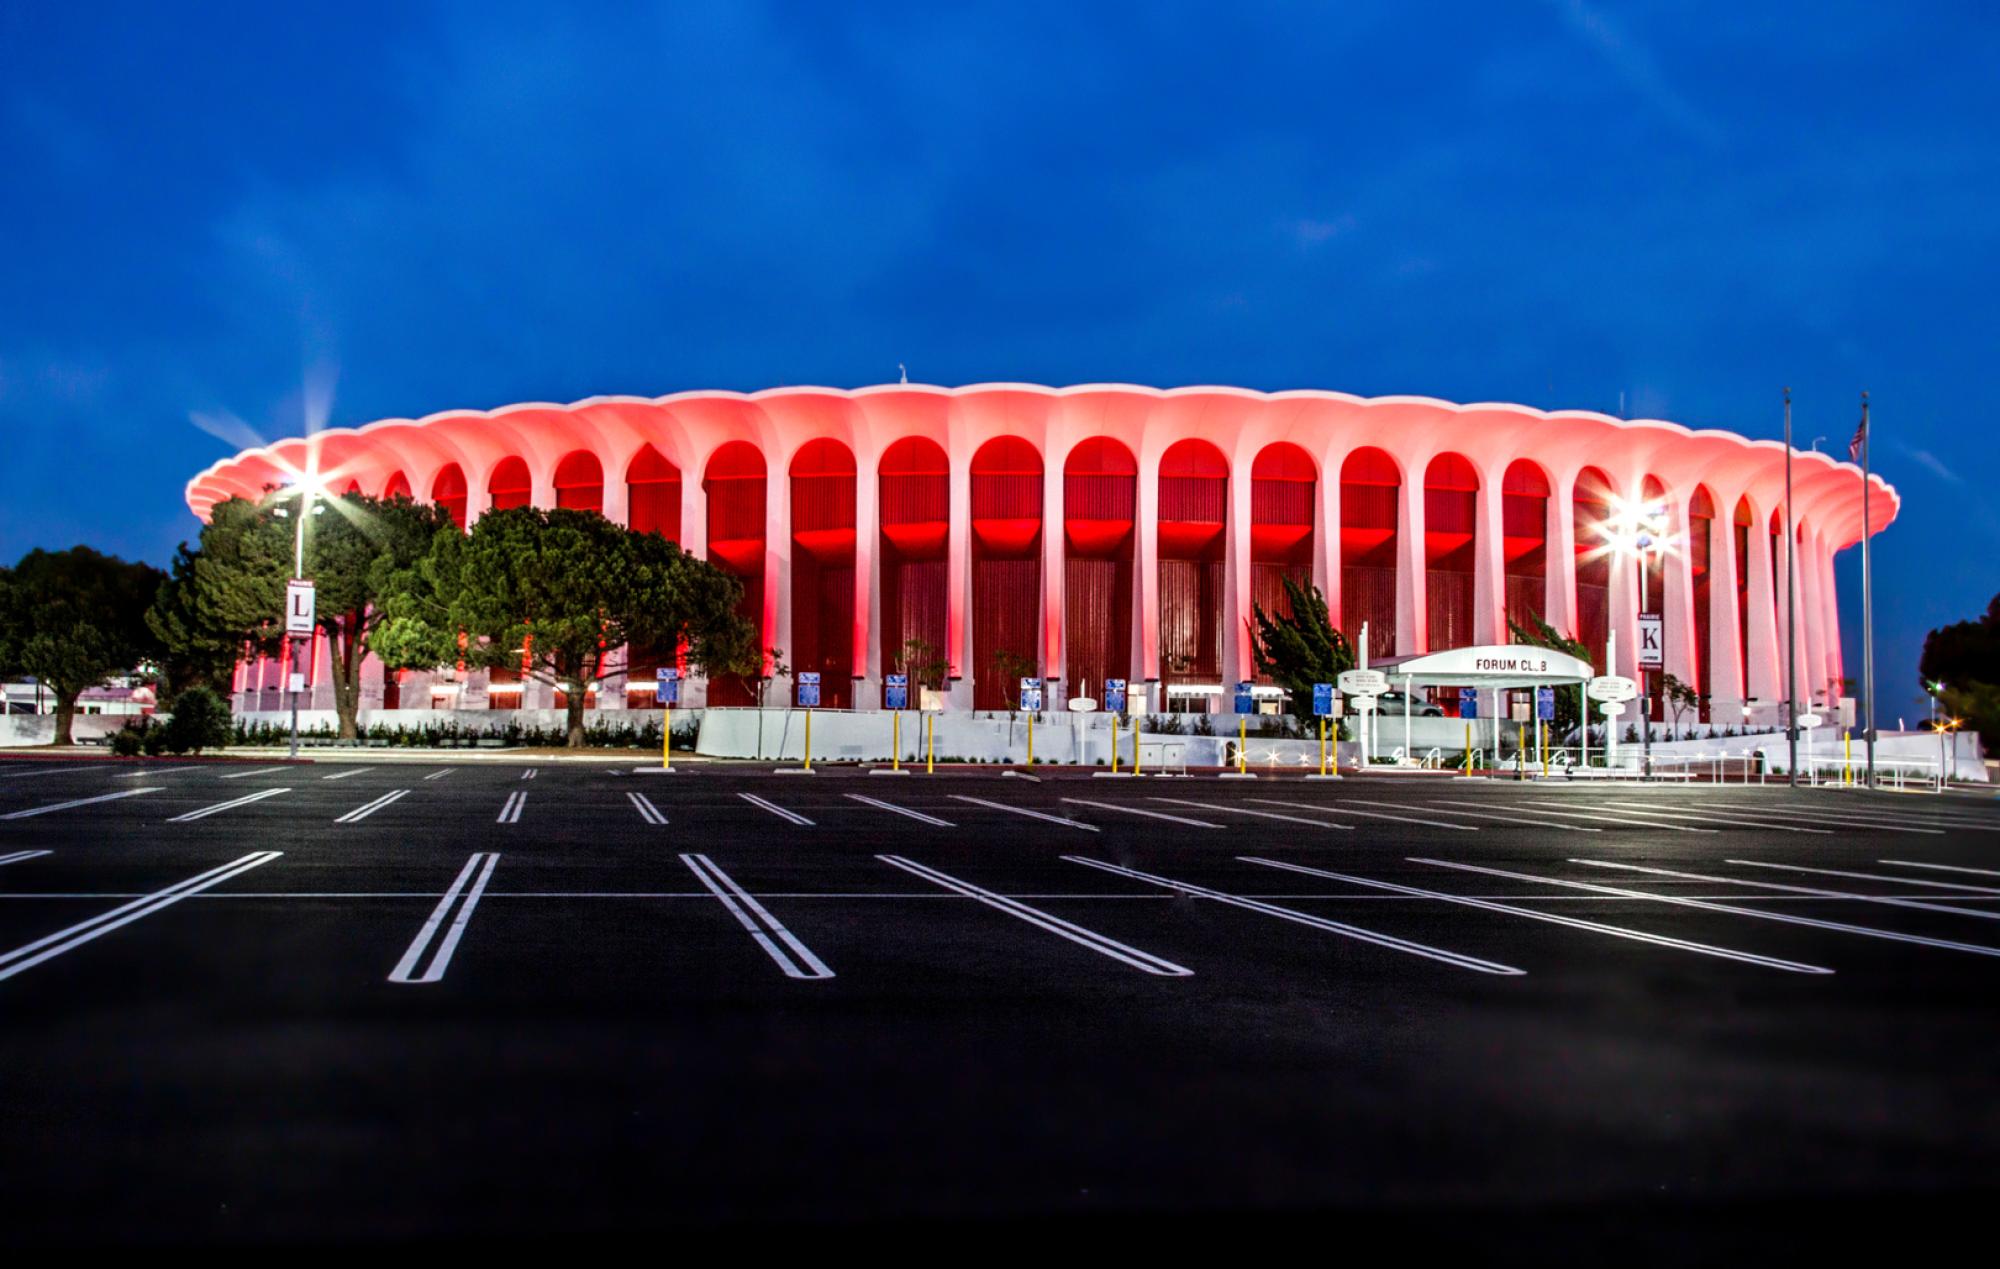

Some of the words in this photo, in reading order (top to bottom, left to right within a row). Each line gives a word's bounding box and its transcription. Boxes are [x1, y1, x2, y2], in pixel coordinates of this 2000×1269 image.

[293, 594, 310, 617] L
[1641, 627, 1658, 650] K
[1476, 659, 1517, 671] FORUM
[1520, 660, 1547, 672] CLB
